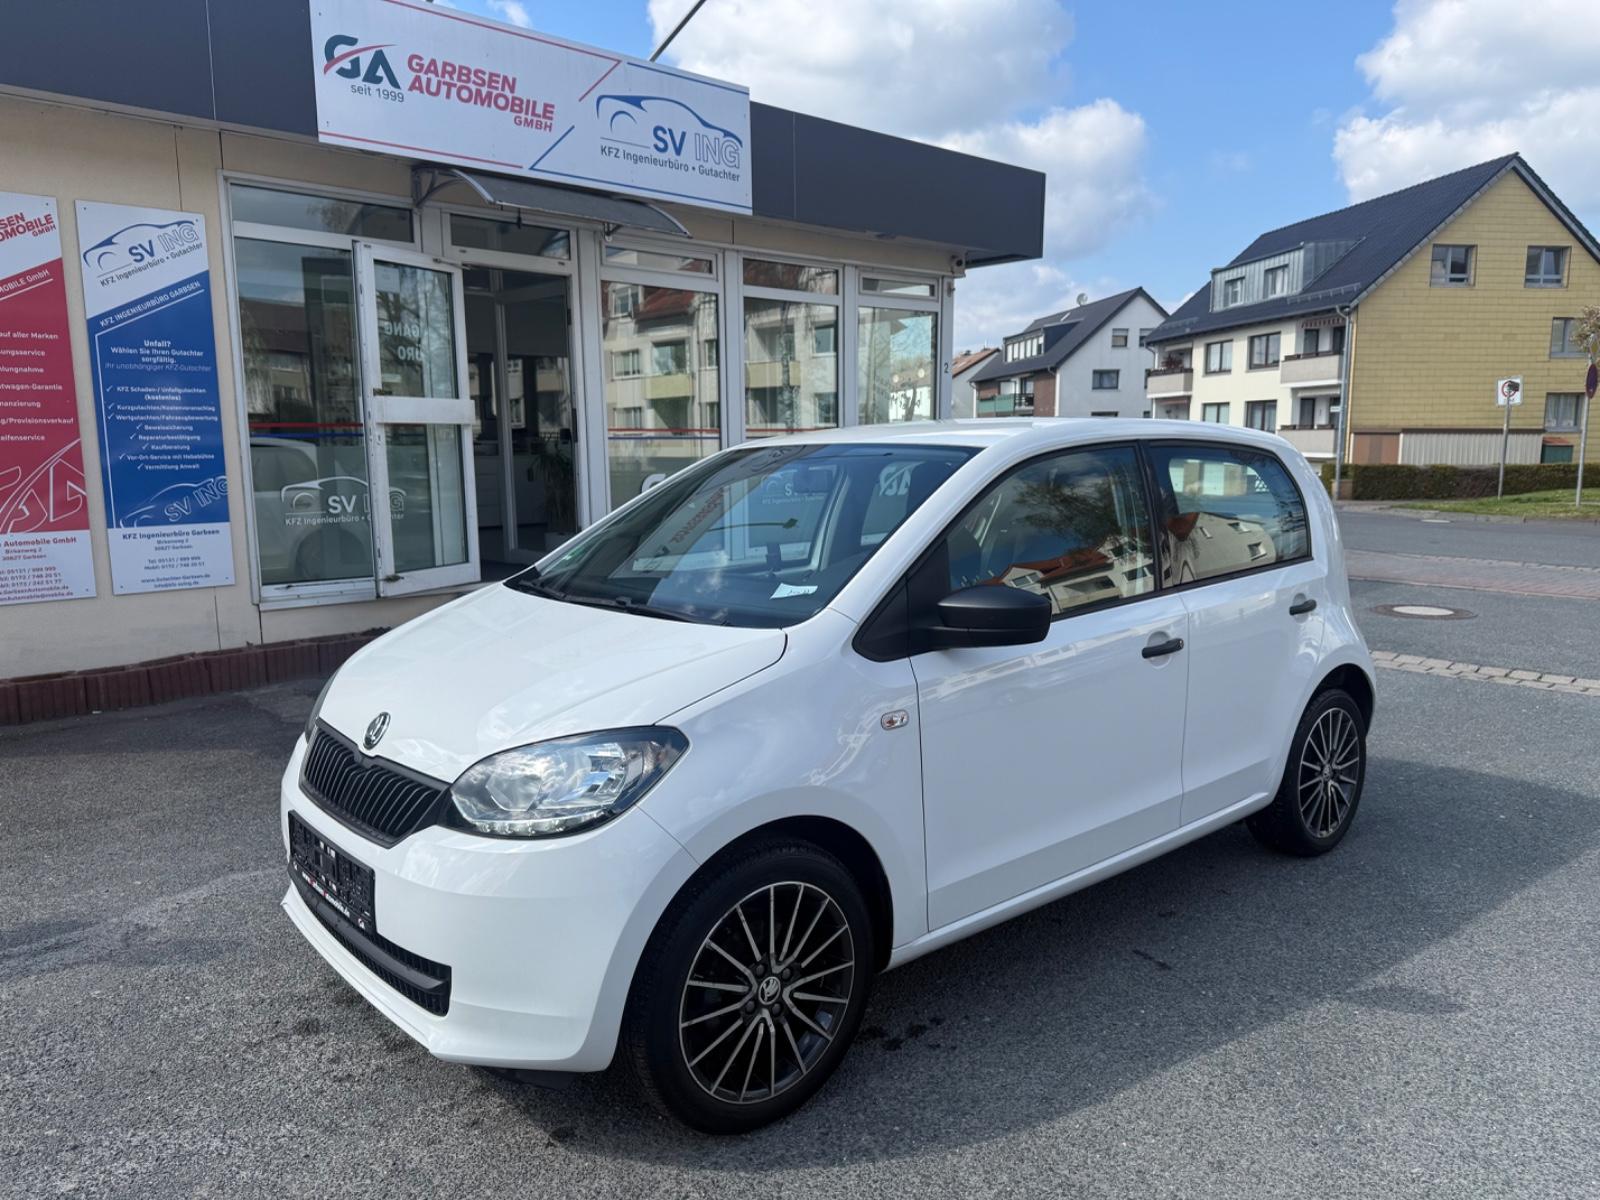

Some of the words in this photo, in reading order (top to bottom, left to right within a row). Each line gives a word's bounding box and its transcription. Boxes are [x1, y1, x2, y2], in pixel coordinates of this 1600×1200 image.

[407, 54, 517, 94] GARBSEN
[351, 84, 372, 96] seit
[376, 88, 404, 103] 1999
[408, 74, 555, 121] AUTOMOBILE
[514, 115, 553, 132] GMBH
[652, 125, 686, 157] SV
[694, 132, 741, 169] ING
[600, 145, 620, 159] KFZ
[623, 150, 689, 172] Ingenieurbüro
[698, 165, 741, 182] Gutachter
[32, 224, 57, 238] GMBH
[128, 240, 155, 263] SV
[158, 224, 199, 253] ING
[100, 276, 116, 287] KFZ
[117, 258, 165, 281] Ingenieurbüro
[170, 242, 203, 260] Gutachter
[100, 317, 115, 327] KFZ
[115, 295, 169, 321] INGENIEURBÜRO
[169, 281, 201, 300] GARBSEN
[12, 331, 29, 339] aller
[31, 332, 59, 340] Marken
[143, 339, 171, 347] Unfall?
[151, 348, 169, 356] Ihren
[171, 348, 204, 357] Gutachter
[943, 361, 950, 374] 2
[164, 496, 192, 522] SV
[327, 495, 357, 514] SV
[285, 518, 303, 526] KFZ
[304, 514, 360, 526] Ingenieurbüro
[4, 537, 51, 548] Automobile
[53, 536, 77, 545] GmbH
[122, 532, 137, 540] KFZ
[139, 529, 190, 540] Ingenieurbüro
[191, 528, 220, 537] Garbsen
